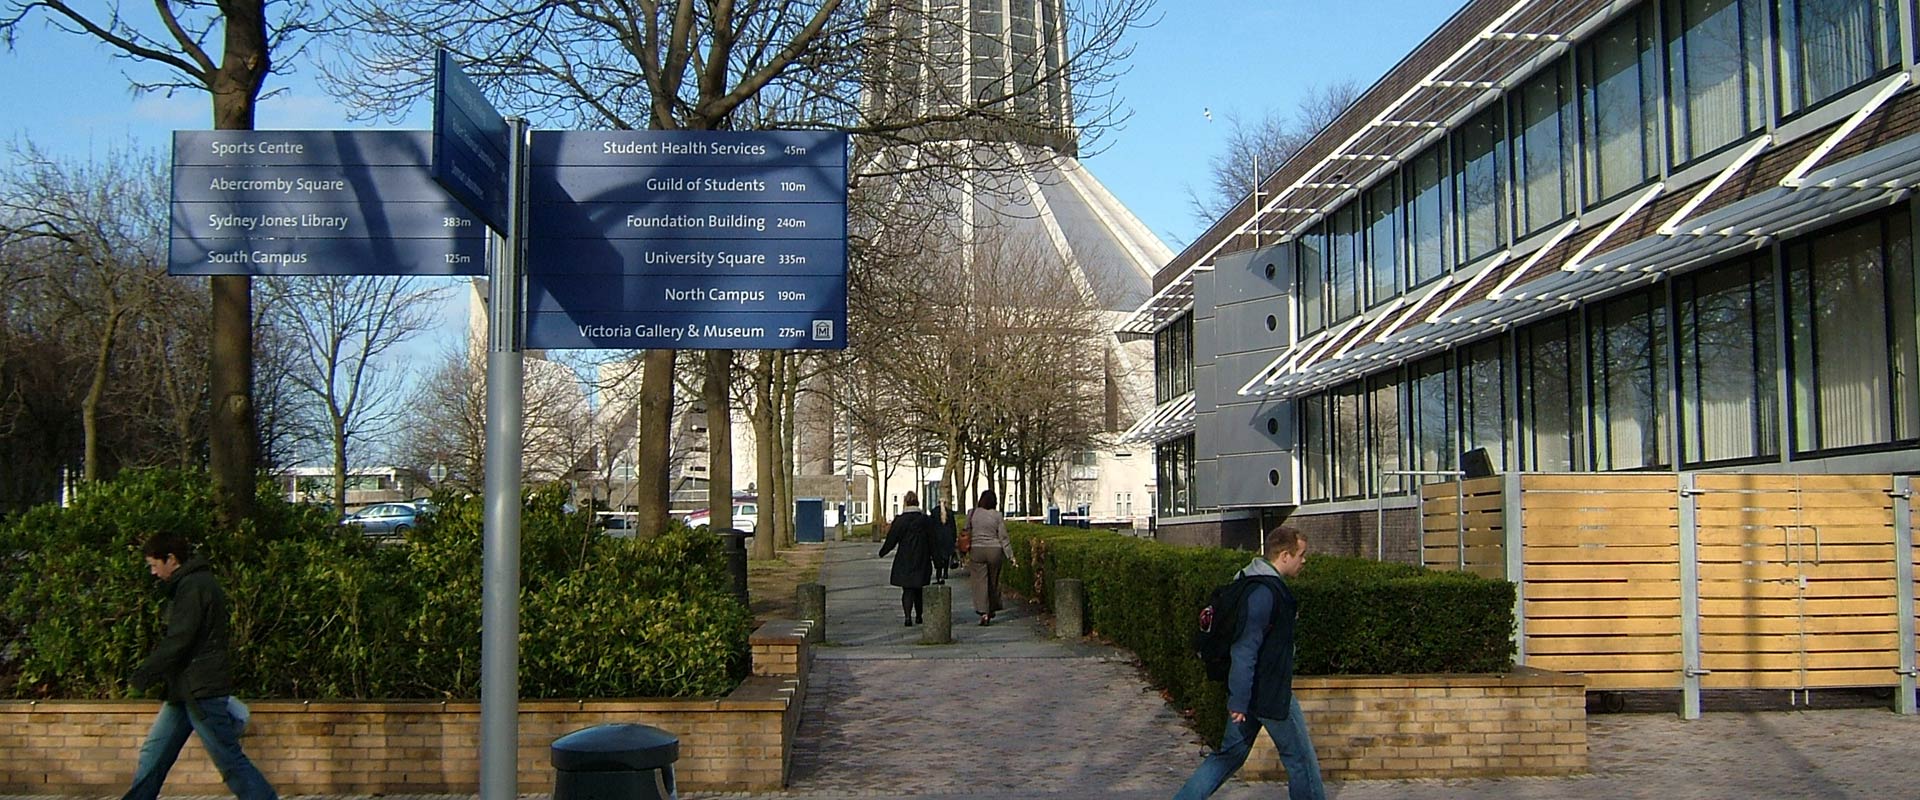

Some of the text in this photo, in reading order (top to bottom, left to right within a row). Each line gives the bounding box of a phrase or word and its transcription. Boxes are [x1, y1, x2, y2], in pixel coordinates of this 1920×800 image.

[211, 141, 304, 156] Sports Centre
[603, 142, 806, 155] Student Health Services 45m
[210, 178, 344, 193] Abercromby Square
[646, 178, 806, 191] Guild of Students 110m
[209, 215, 471, 230] Sydney Jones Library 383m
[627, 215, 806, 231] Foundation Building 240m
[208, 251, 470, 266] South Campus 125m
[645, 252, 806, 267] University Square 335m
[665, 288, 806, 304] North Campus 190m
[578, 325, 805, 341] Victoria Gallery & Museum 275m
